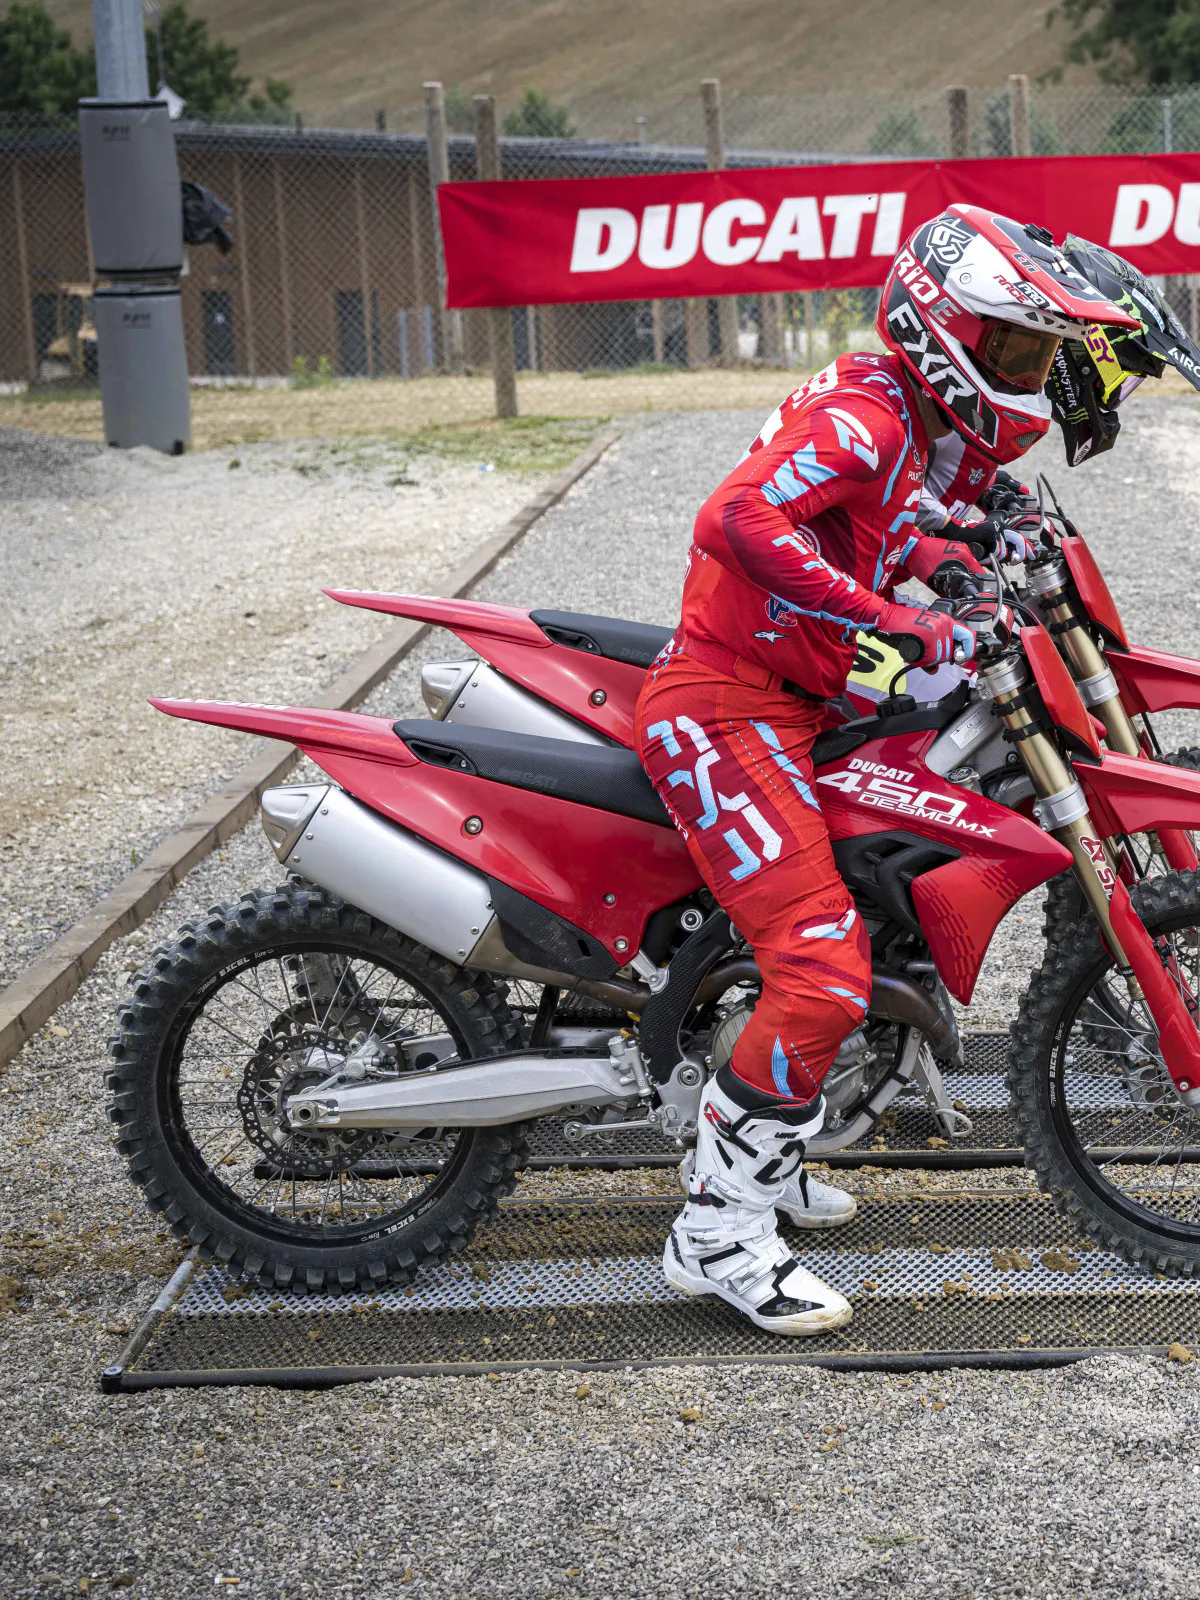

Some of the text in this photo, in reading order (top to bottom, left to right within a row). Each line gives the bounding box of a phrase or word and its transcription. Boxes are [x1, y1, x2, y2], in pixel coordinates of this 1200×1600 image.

[569, 192, 907, 273] DUCATI
[894, 249, 962, 326] RIDE
[993, 274, 1029, 304] RACE
[1017, 282, 1046, 306] PRO
[887, 302, 979, 405] FXR
[1051, 367, 1064, 401] NERGY
[1055, 348, 1077, 408] MONSTER
[848, 758, 915, 783] DUCATI
[816, 771, 968, 817] 450
[858, 793, 998, 838] DESMO MX
[219, 957, 251, 977] EXCEL
[1049, 1045, 1059, 1078] EXCEL
[384, 1214, 416, 1234] EXCEL
